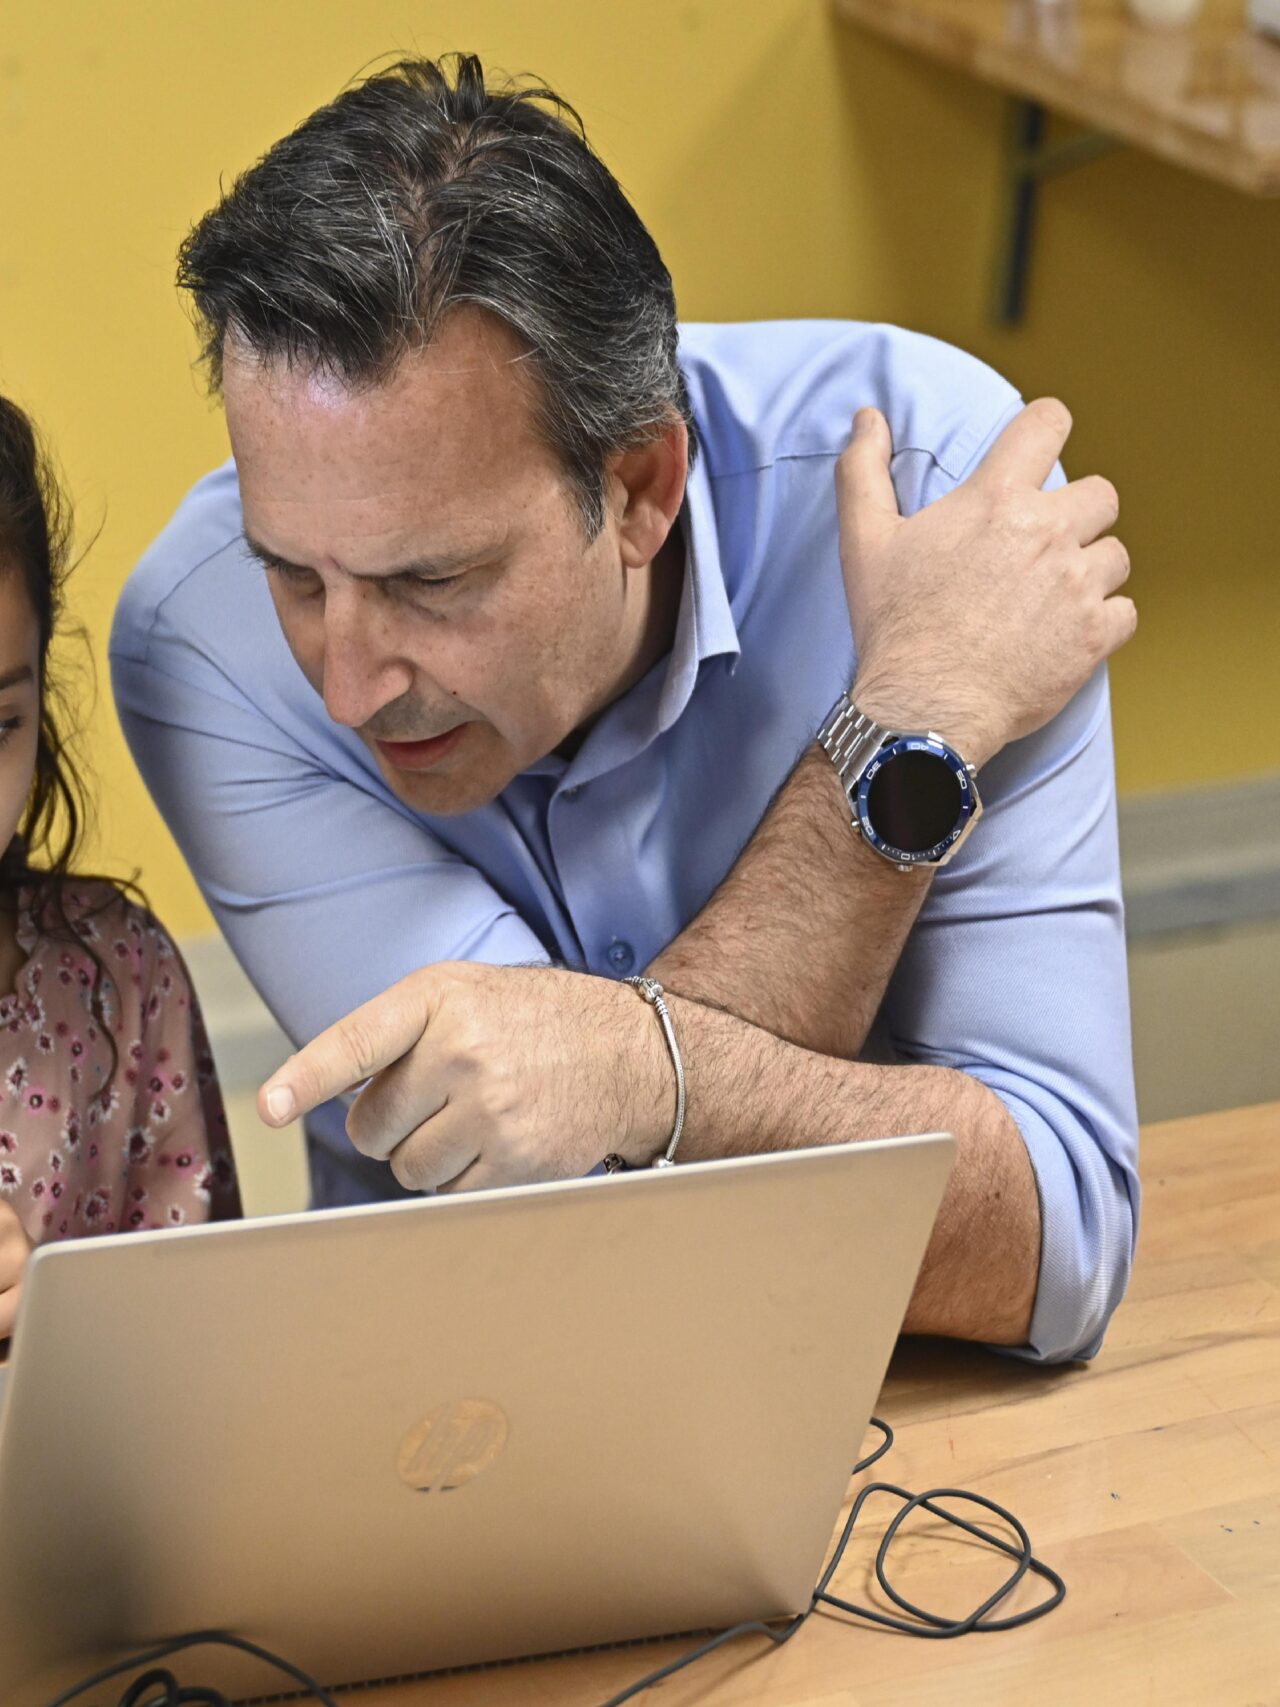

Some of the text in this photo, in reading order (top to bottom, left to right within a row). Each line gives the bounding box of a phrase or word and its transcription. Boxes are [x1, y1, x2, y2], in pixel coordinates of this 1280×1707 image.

[910, 742, 929, 751] 40
[866, 760, 882, 780] 30
[956, 769, 968, 790] 50
[861, 815, 874, 836] 20
[901, 852, 916, 861] 10
[397, 1397, 509, 1492] hp
